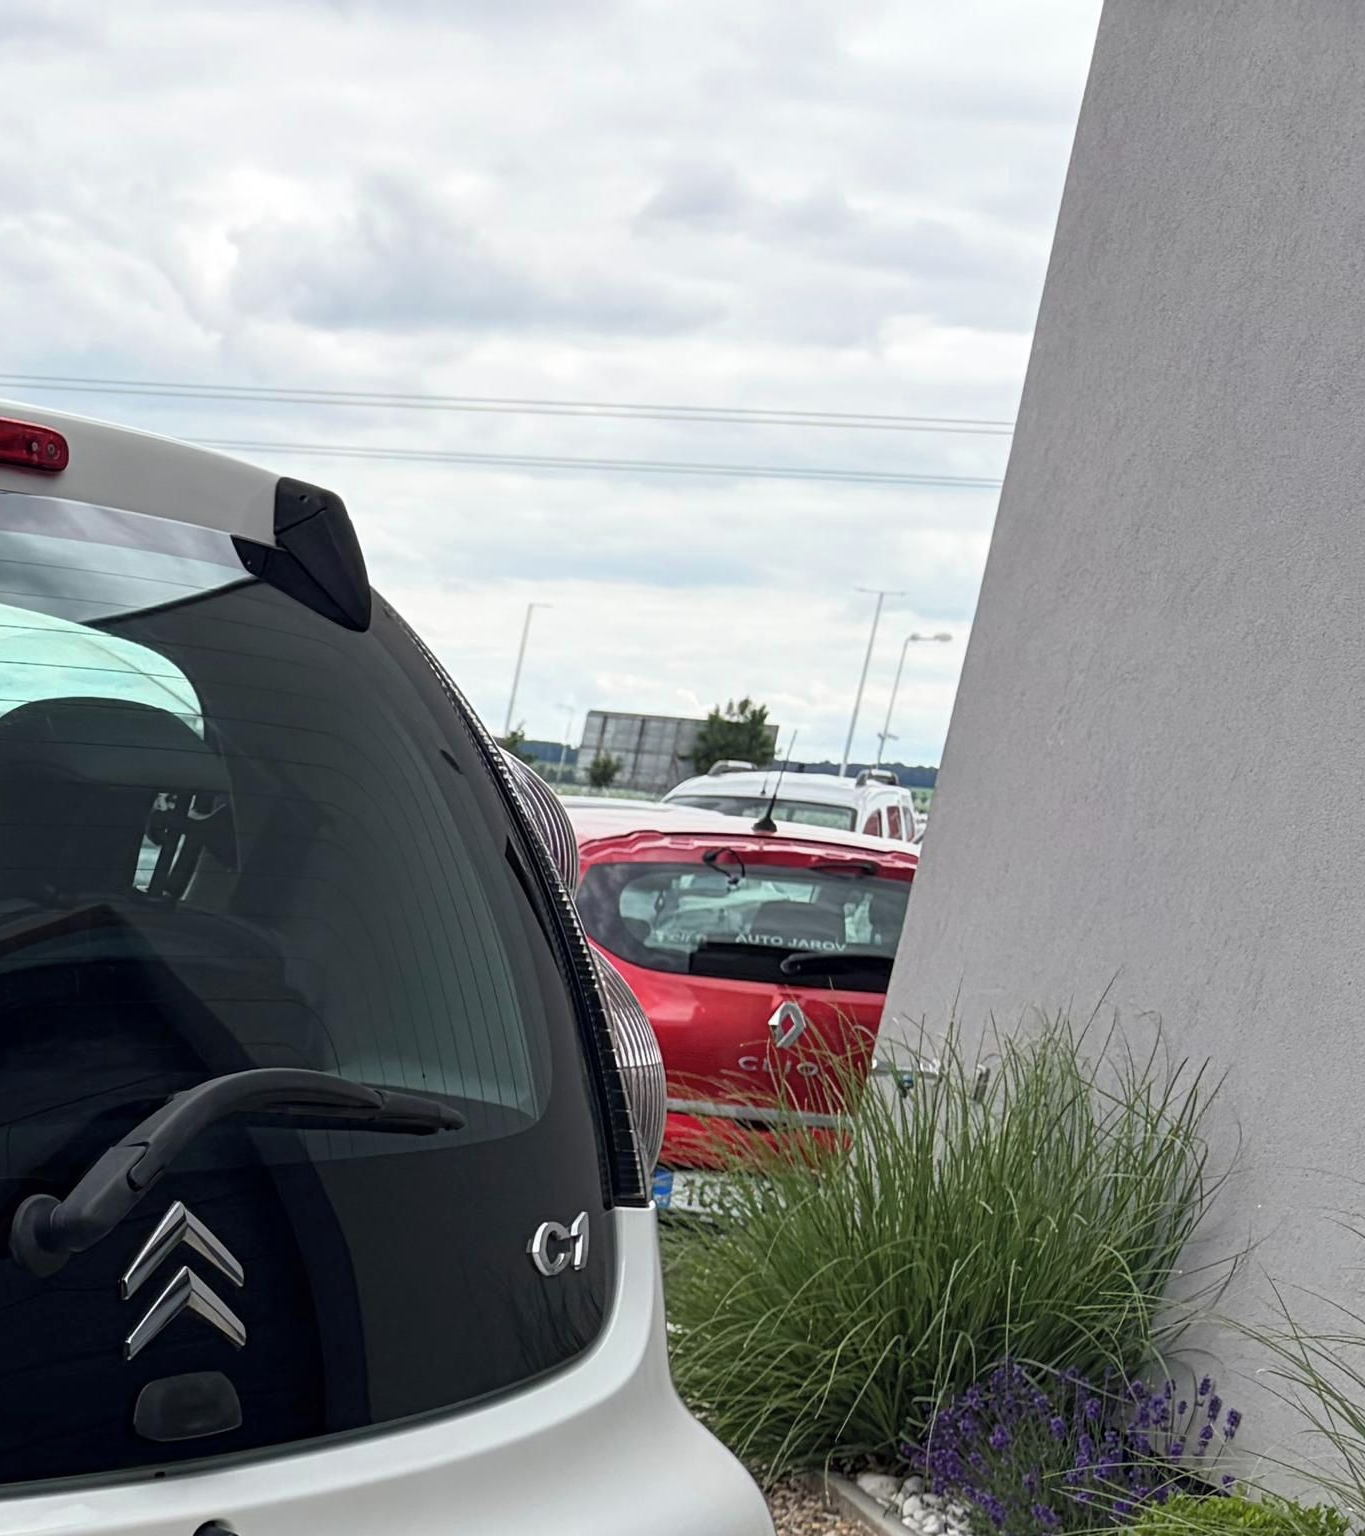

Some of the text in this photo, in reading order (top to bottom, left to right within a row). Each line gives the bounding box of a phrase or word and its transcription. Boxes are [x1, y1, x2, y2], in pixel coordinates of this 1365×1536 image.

[735, 932, 847, 952] AUTO JAROV
[530, 1211, 589, 1276] C1
